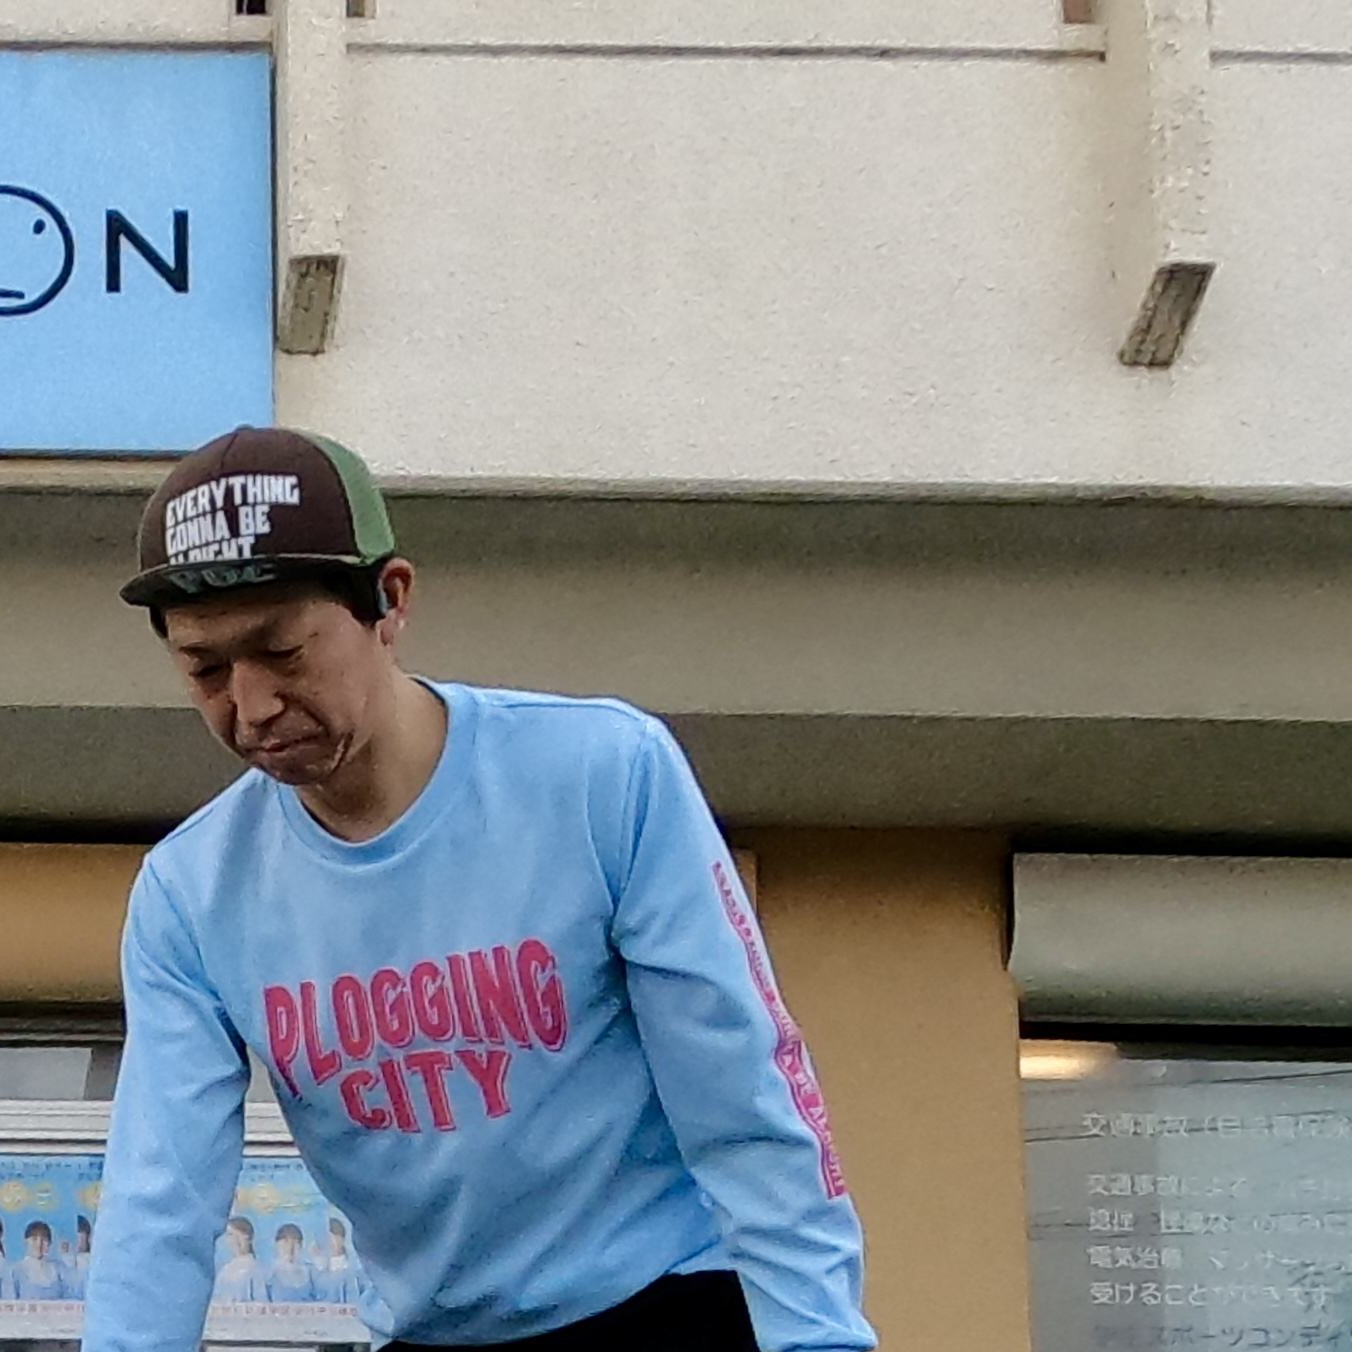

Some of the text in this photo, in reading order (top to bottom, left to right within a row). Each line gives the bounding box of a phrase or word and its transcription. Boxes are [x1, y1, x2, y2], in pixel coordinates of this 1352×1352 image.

[165, 474, 301, 528] EVERYTHING
[165, 504, 272, 556] GONNA BE
[263, 938, 568, 1101] PLOGGING
[340, 1049, 512, 1133] CITY
